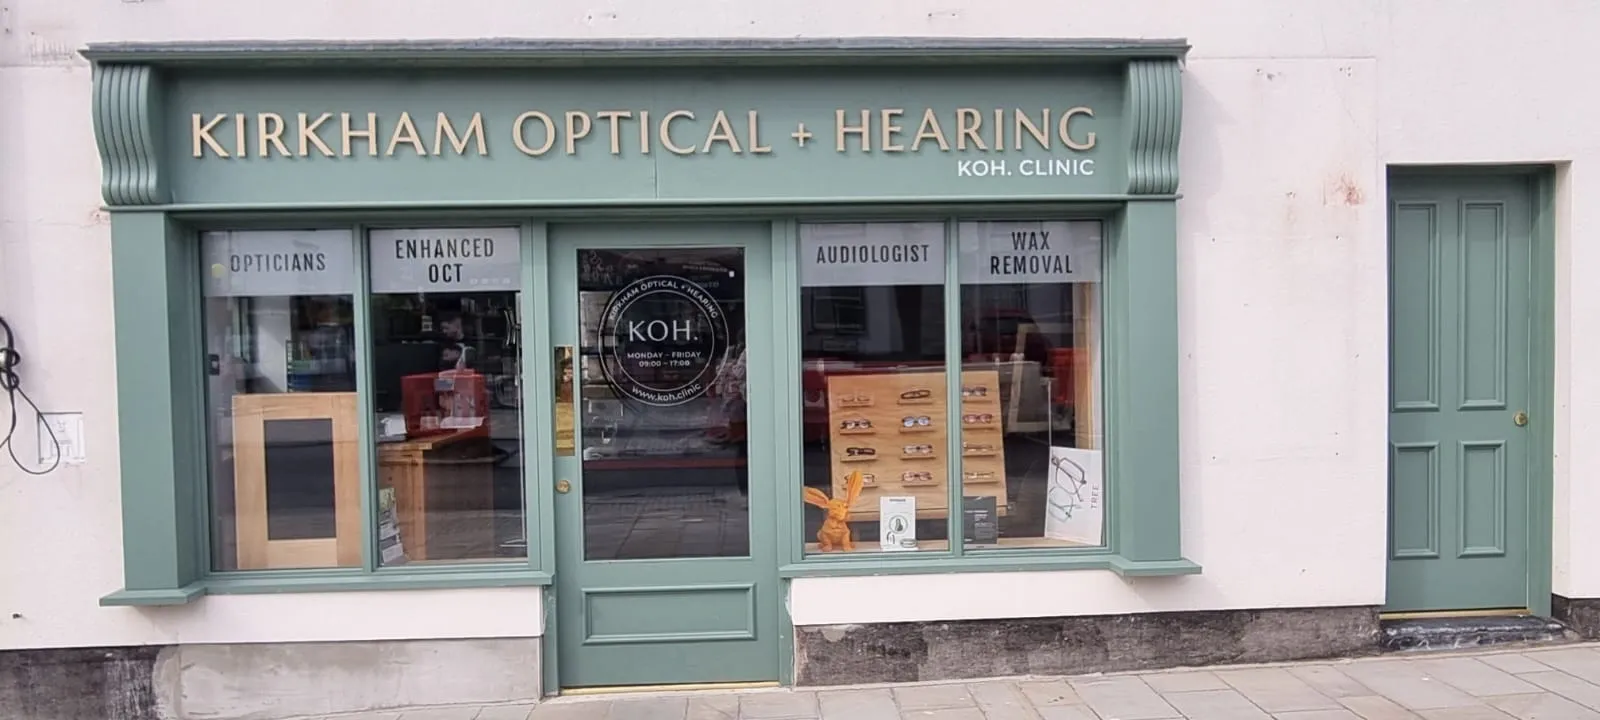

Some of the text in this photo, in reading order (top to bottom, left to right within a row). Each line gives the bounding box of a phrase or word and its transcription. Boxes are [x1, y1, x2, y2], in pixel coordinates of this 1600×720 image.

[191, 106, 1097, 158] KIRKHAM OPTICAL + HEARING
[957, 159, 1095, 177] KOH. CLINIC
[395, 238, 494, 260] ENHANCED
[1011, 231, 1051, 251] WAX
[230, 252, 327, 273] OPTICIANS
[816, 244, 930, 265] AUDIOLOGIST
[428, 263, 463, 284] OCT
[990, 255, 1073, 276] REMOVAL
[608, 287, 640, 322] KIRKHAM
[640, 279, 679, 291] OPTICAL
[686, 285, 719, 319] HEARING
[628, 319, 698, 342] KOH.
[627, 351, 663, 359] MONDAY
[631, 383, 702, 403] www.koh.clinic
[1090, 484, 1099, 509] TREE
